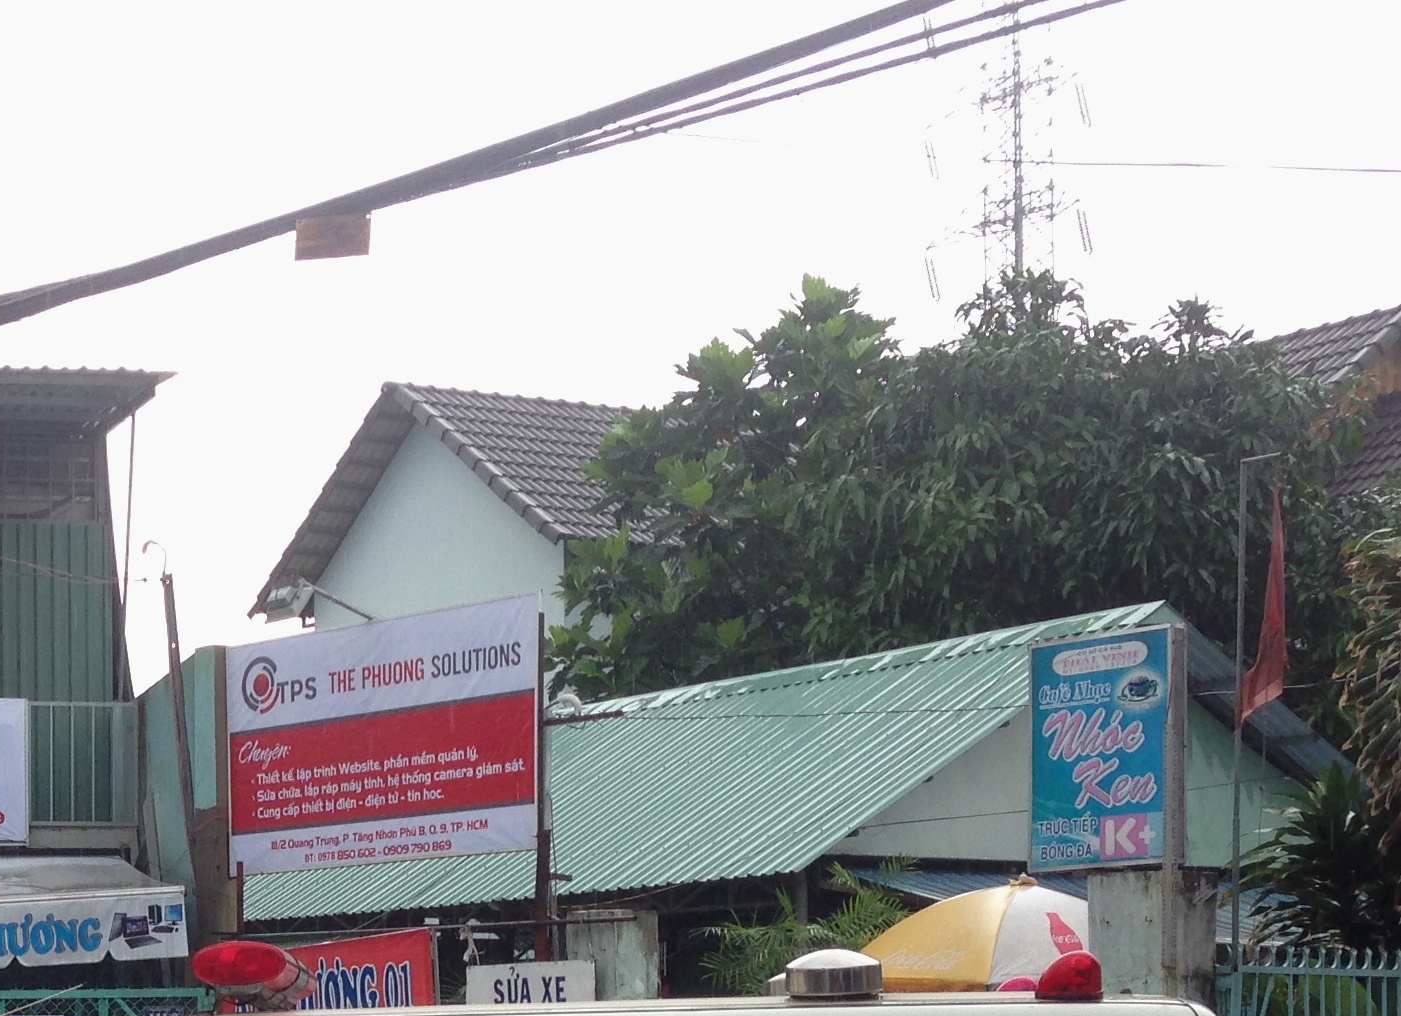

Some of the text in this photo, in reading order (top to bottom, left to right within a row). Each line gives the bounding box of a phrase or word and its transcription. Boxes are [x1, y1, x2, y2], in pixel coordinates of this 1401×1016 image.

[276, 641, 522, 705] TPS THE PHUONG SOLUTIONS
[433, 767, 474, 782] camera
[1072, 756, 1158, 810] Ken
[256, 806, 281, 821] Cung
[407, 788, 421, 802] tin
[287, 838, 314, 850] Quang
[400, 826, 417, 839] Phú
[466, 818, 489, 832] HCM
[337, 848, 356, 861] 850
[357, 846, 377, 859] 602
[383, 844, 410, 857] 0909
[411, 842, 431, 854] 790
[431, 839, 453, 852] 869
[383, 959, 412, 1007] 01
[493, 966, 567, 1004] SỬA XE
